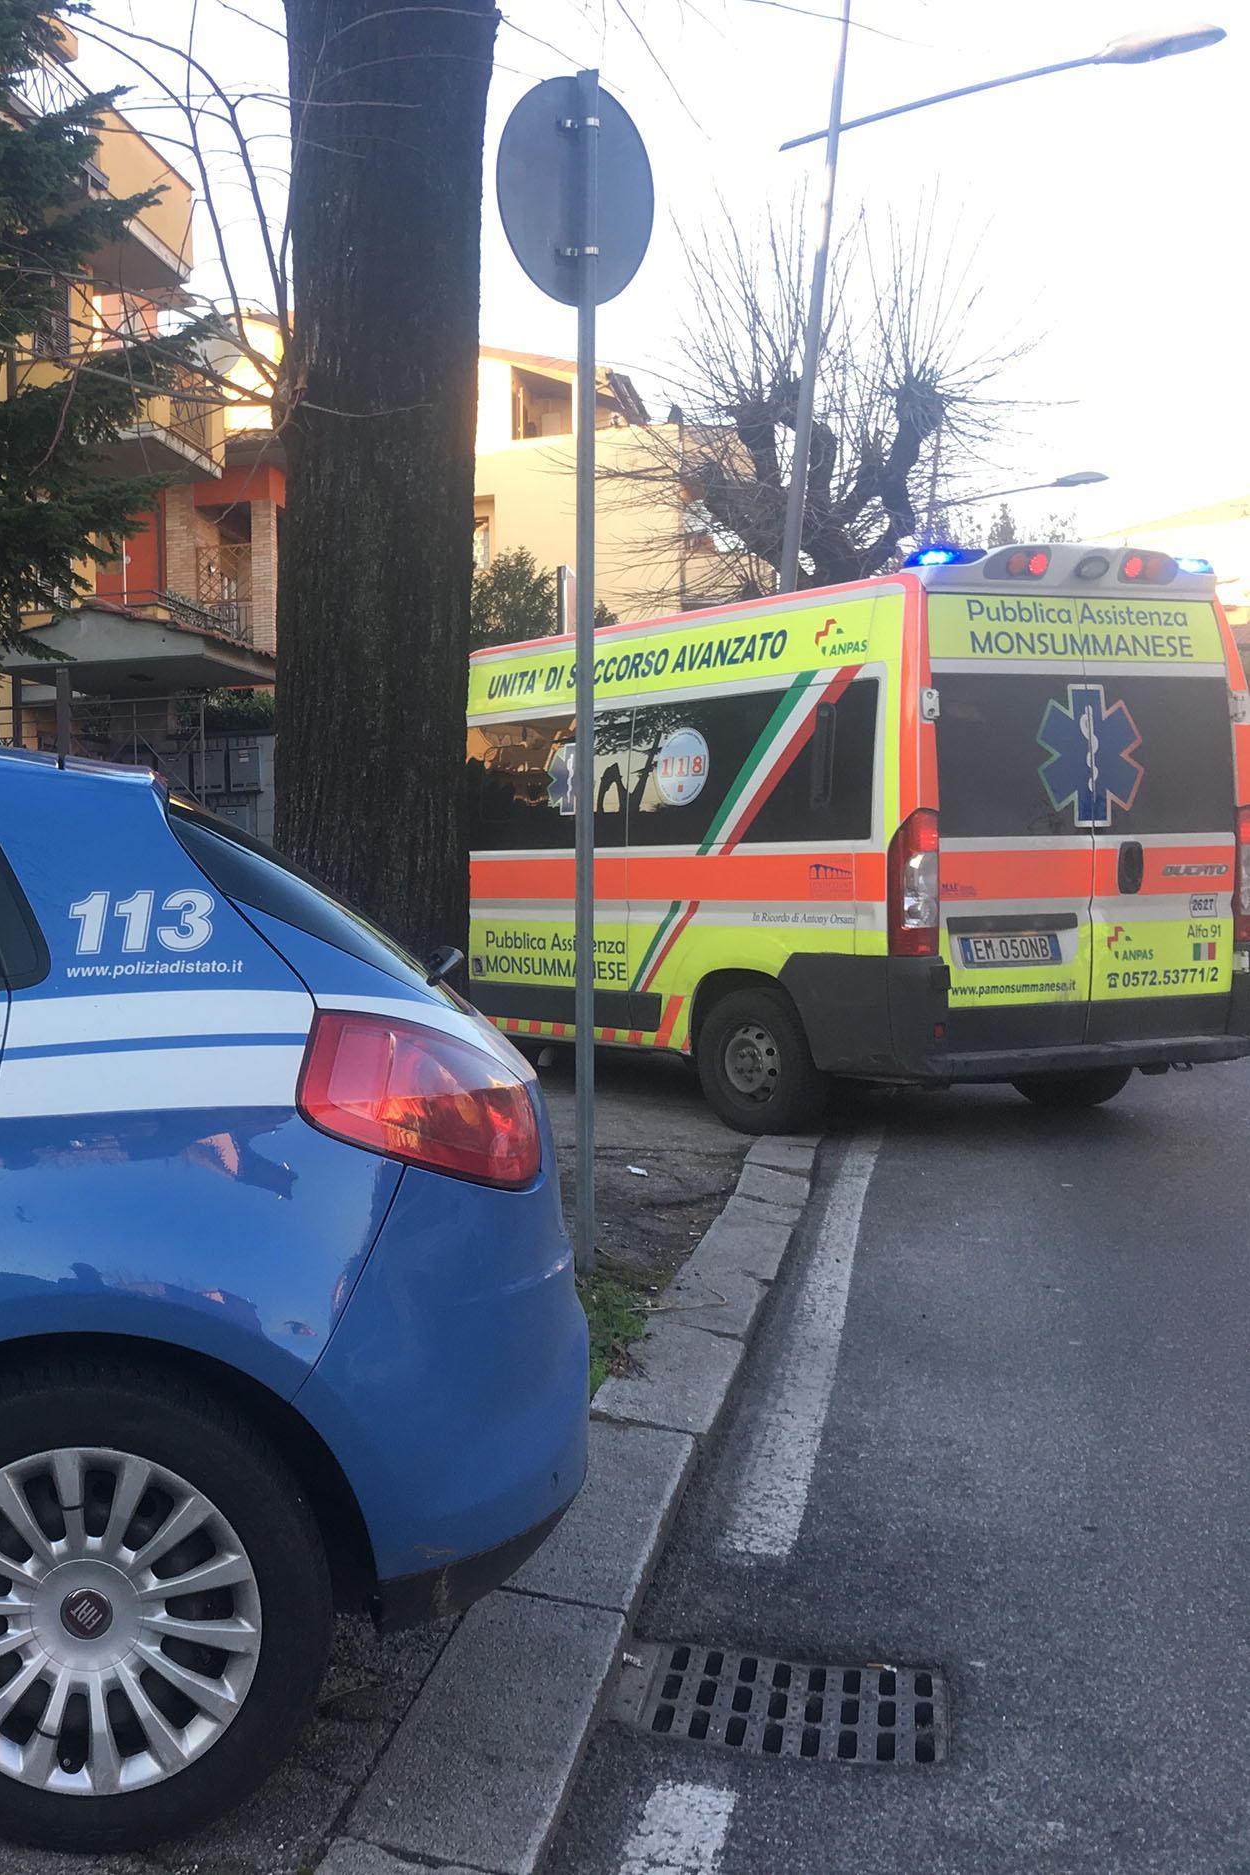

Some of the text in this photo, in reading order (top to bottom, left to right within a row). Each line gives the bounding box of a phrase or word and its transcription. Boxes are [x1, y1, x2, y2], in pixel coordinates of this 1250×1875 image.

[965, 599, 1189, 628] Pubblica Assistenza
[828, 639, 869, 657] ANPAS
[968, 630, 1195, 658] MONSUMMANESE
[487, 629, 788, 700] UNITA' DI SCCORSO AVANZATO
[660, 755, 703, 776] 118
[1192, 898, 1215, 912] 2627
[68, 888, 215, 956] 113
[752, 912, 761, 922] In
[761, 912, 791, 923] Ricordo
[791, 912, 799, 923] di
[800, 913, 829, 926] Antony
[1187, 924, 1222, 939] Alfa 91
[485, 931, 626, 955] Pubblica Assienza
[973, 939, 996, 960] EM
[1121, 948, 1155, 961] ANPAS
[67, 960, 244, 979] www.poliziadistato.it
[485, 955, 628, 982] MONSUMMESE
[1122, 967, 1220, 988] 0572.53771/2
[950, 979, 1077, 998] www.pamonsummanese.it
[69, 1599, 103, 1631] FIAT
